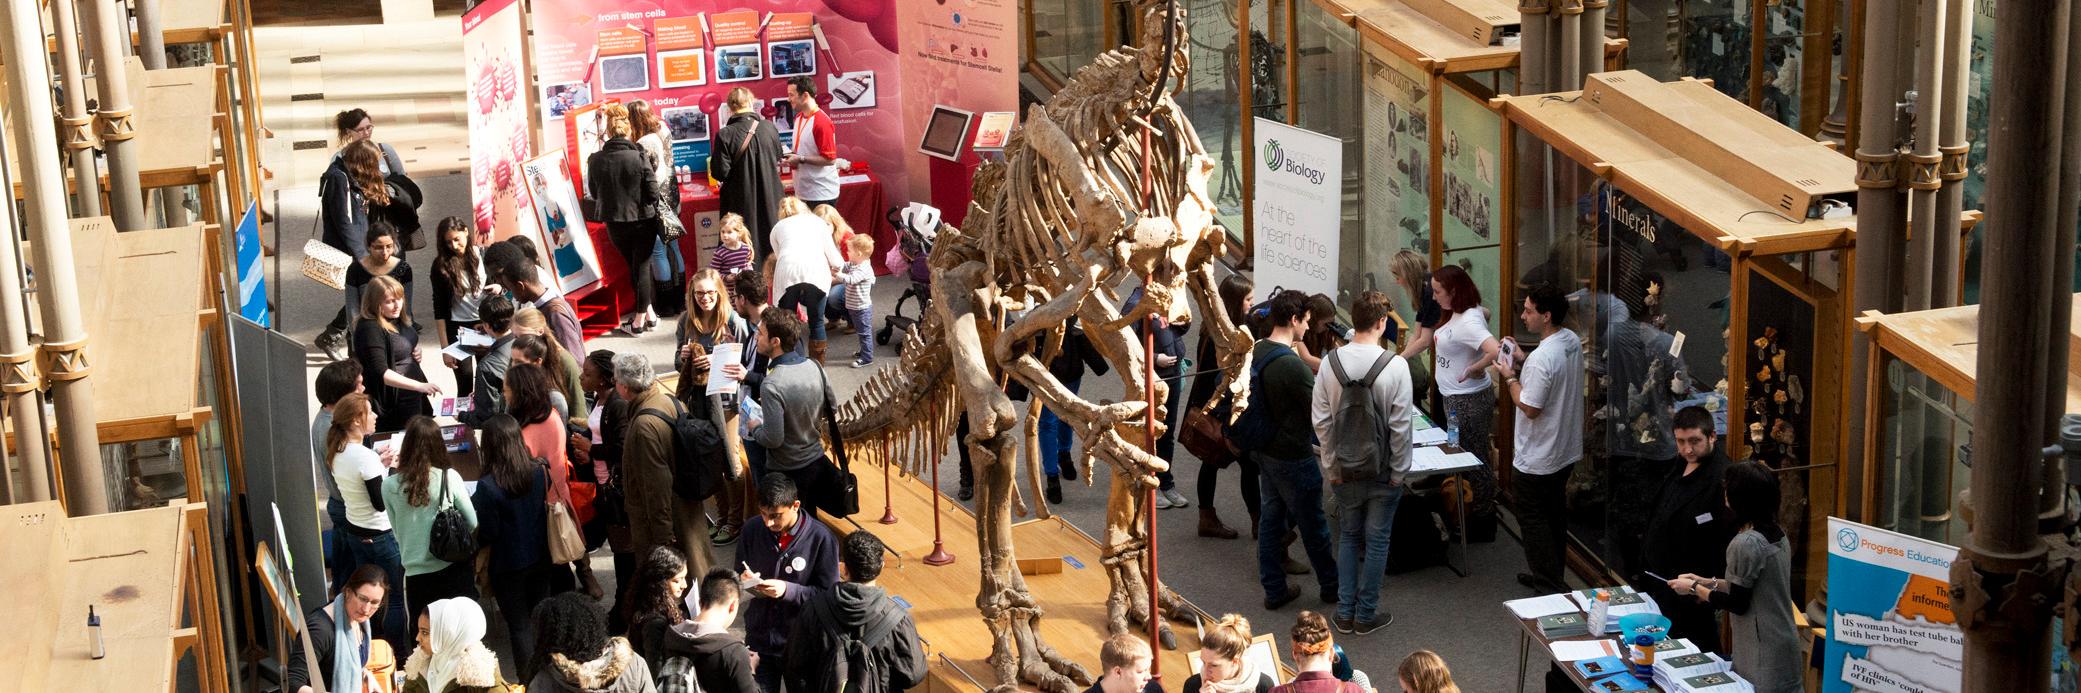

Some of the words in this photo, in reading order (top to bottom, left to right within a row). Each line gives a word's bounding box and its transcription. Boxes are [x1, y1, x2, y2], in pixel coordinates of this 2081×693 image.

[599, 13, 619, 22] from
[622, 11, 643, 20] stem
[645, 9, 666, 18] cells
[654, 97, 679, 107] today
[1286, 158, 1326, 185] Biology
[1261, 200, 1274, 221] At
[1278, 205, 1295, 226] the
[1605, 190, 1656, 243] Minerals
[1261, 223, 1292, 247] heart
[1295, 234, 1306, 251] of
[1308, 238, 1327, 259] the
[1260, 243, 1275, 264] life
[1278, 252, 1328, 281] sciences
[1861, 539, 1905, 557] Progress
[1912, 593, 1951, 611] informe
[1842, 617, 1854, 628] US
[1856, 621, 1890, 633] woman
[1892, 624, 1908, 635] has
[1910, 628, 1926, 639] test
[1929, 630, 1948, 643] tube
[1842, 629, 1863, 640] with
[1865, 630, 1881, 642] her
[1883, 633, 1919, 647] brother
[1851, 672, 1860, 680] of
[1852, 663, 1868, 674] IVF
[1868, 670, 1896, 686] clinics
